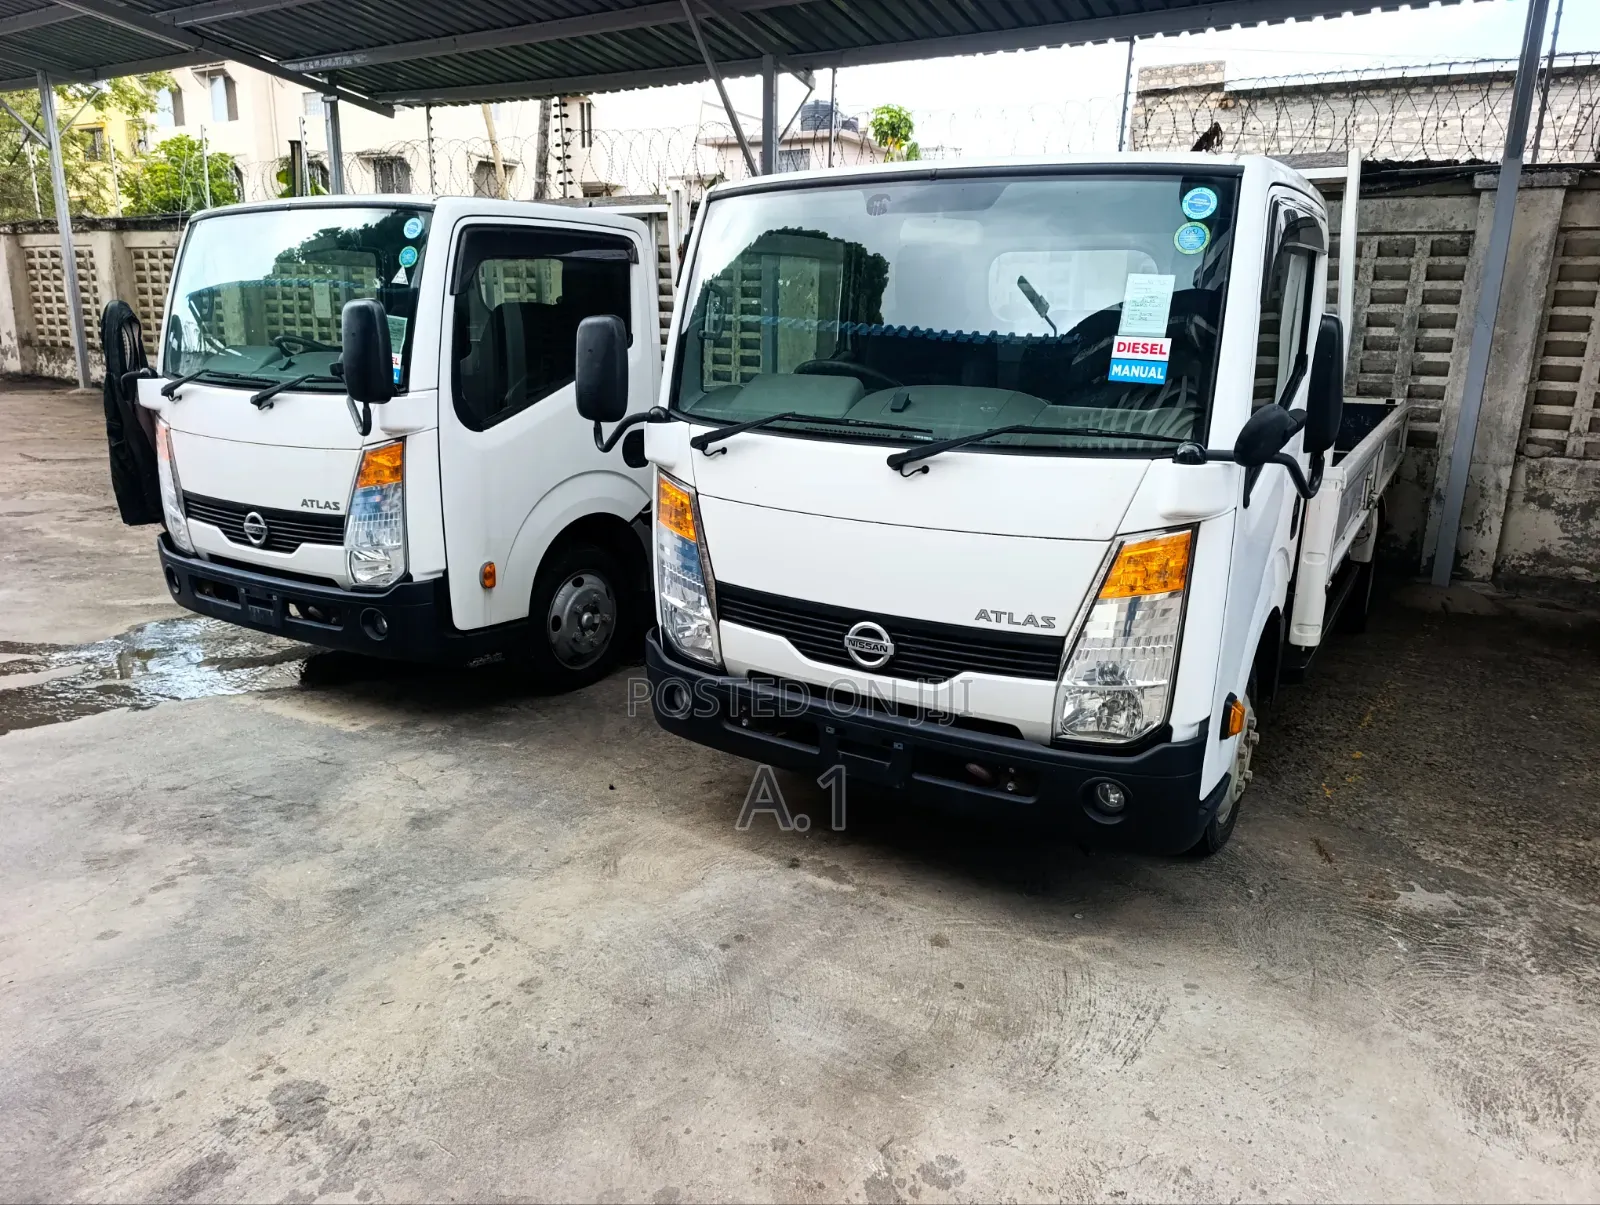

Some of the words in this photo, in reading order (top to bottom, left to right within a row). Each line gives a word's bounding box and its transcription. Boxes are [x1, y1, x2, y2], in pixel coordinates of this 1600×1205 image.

[1116, 341, 1167, 355] DIESEL
[1111, 364, 1164, 380] MANUAL
[300, 499, 341, 511] ATLAS
[974, 608, 1056, 629] ATLAS
[848, 639, 889, 653] NISSAN
